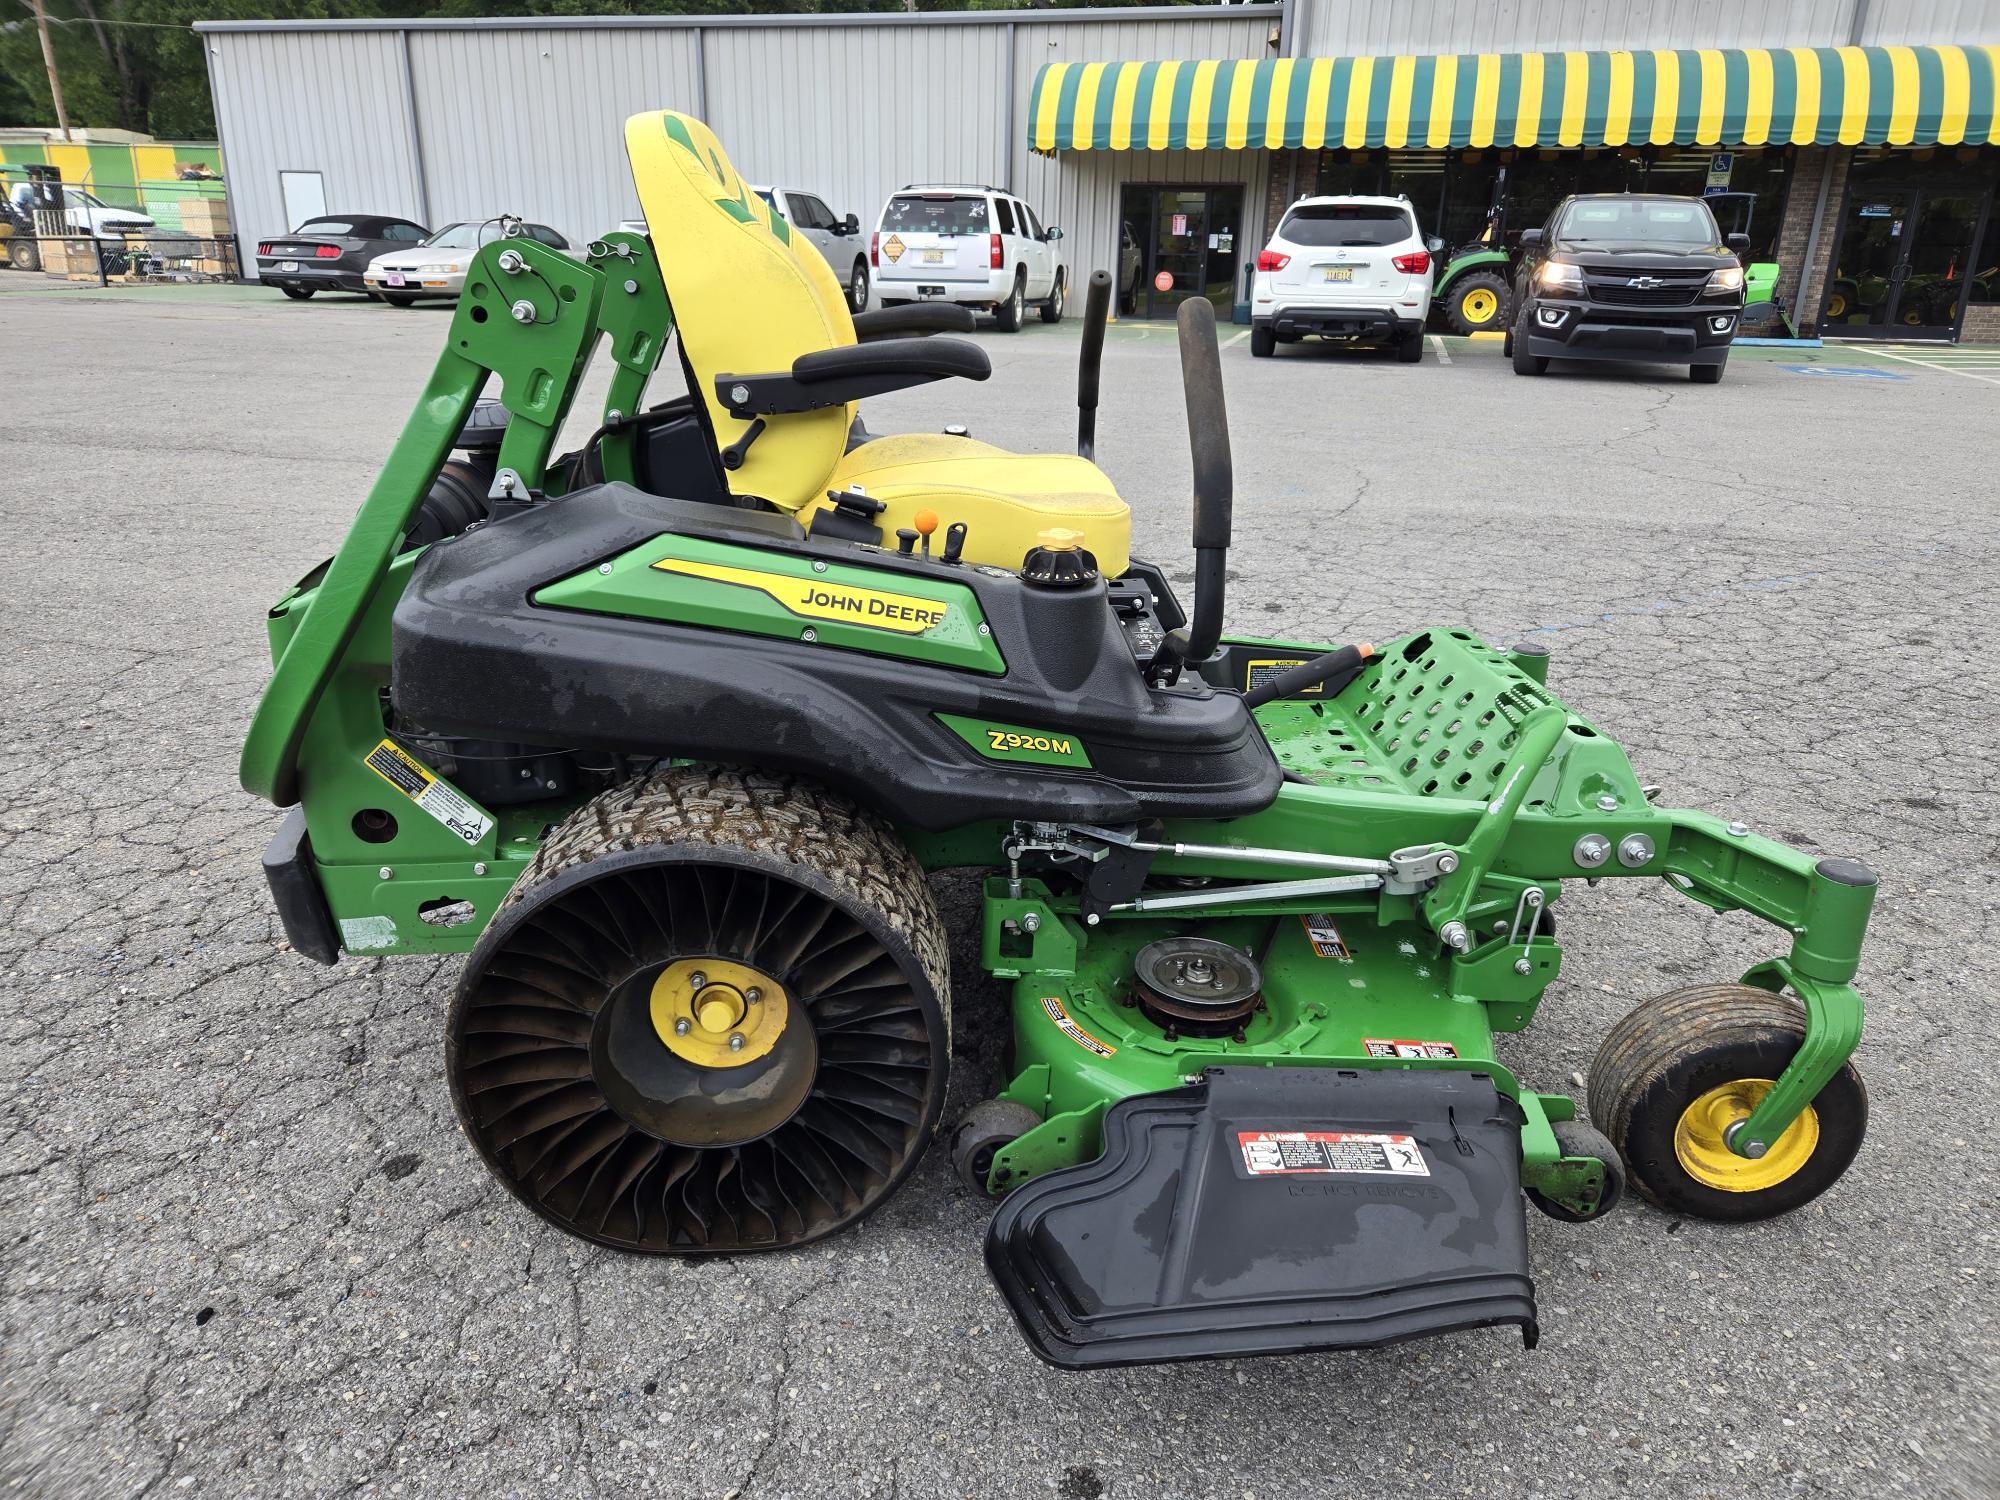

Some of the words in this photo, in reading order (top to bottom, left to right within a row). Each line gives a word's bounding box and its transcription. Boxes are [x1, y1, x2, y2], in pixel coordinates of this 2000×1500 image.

[801, 588, 863, 613] JOHN
[868, 598, 944, 625] DEERE
[986, 730, 1072, 755] Z920M
[398, 752, 424, 775] CAUTION
